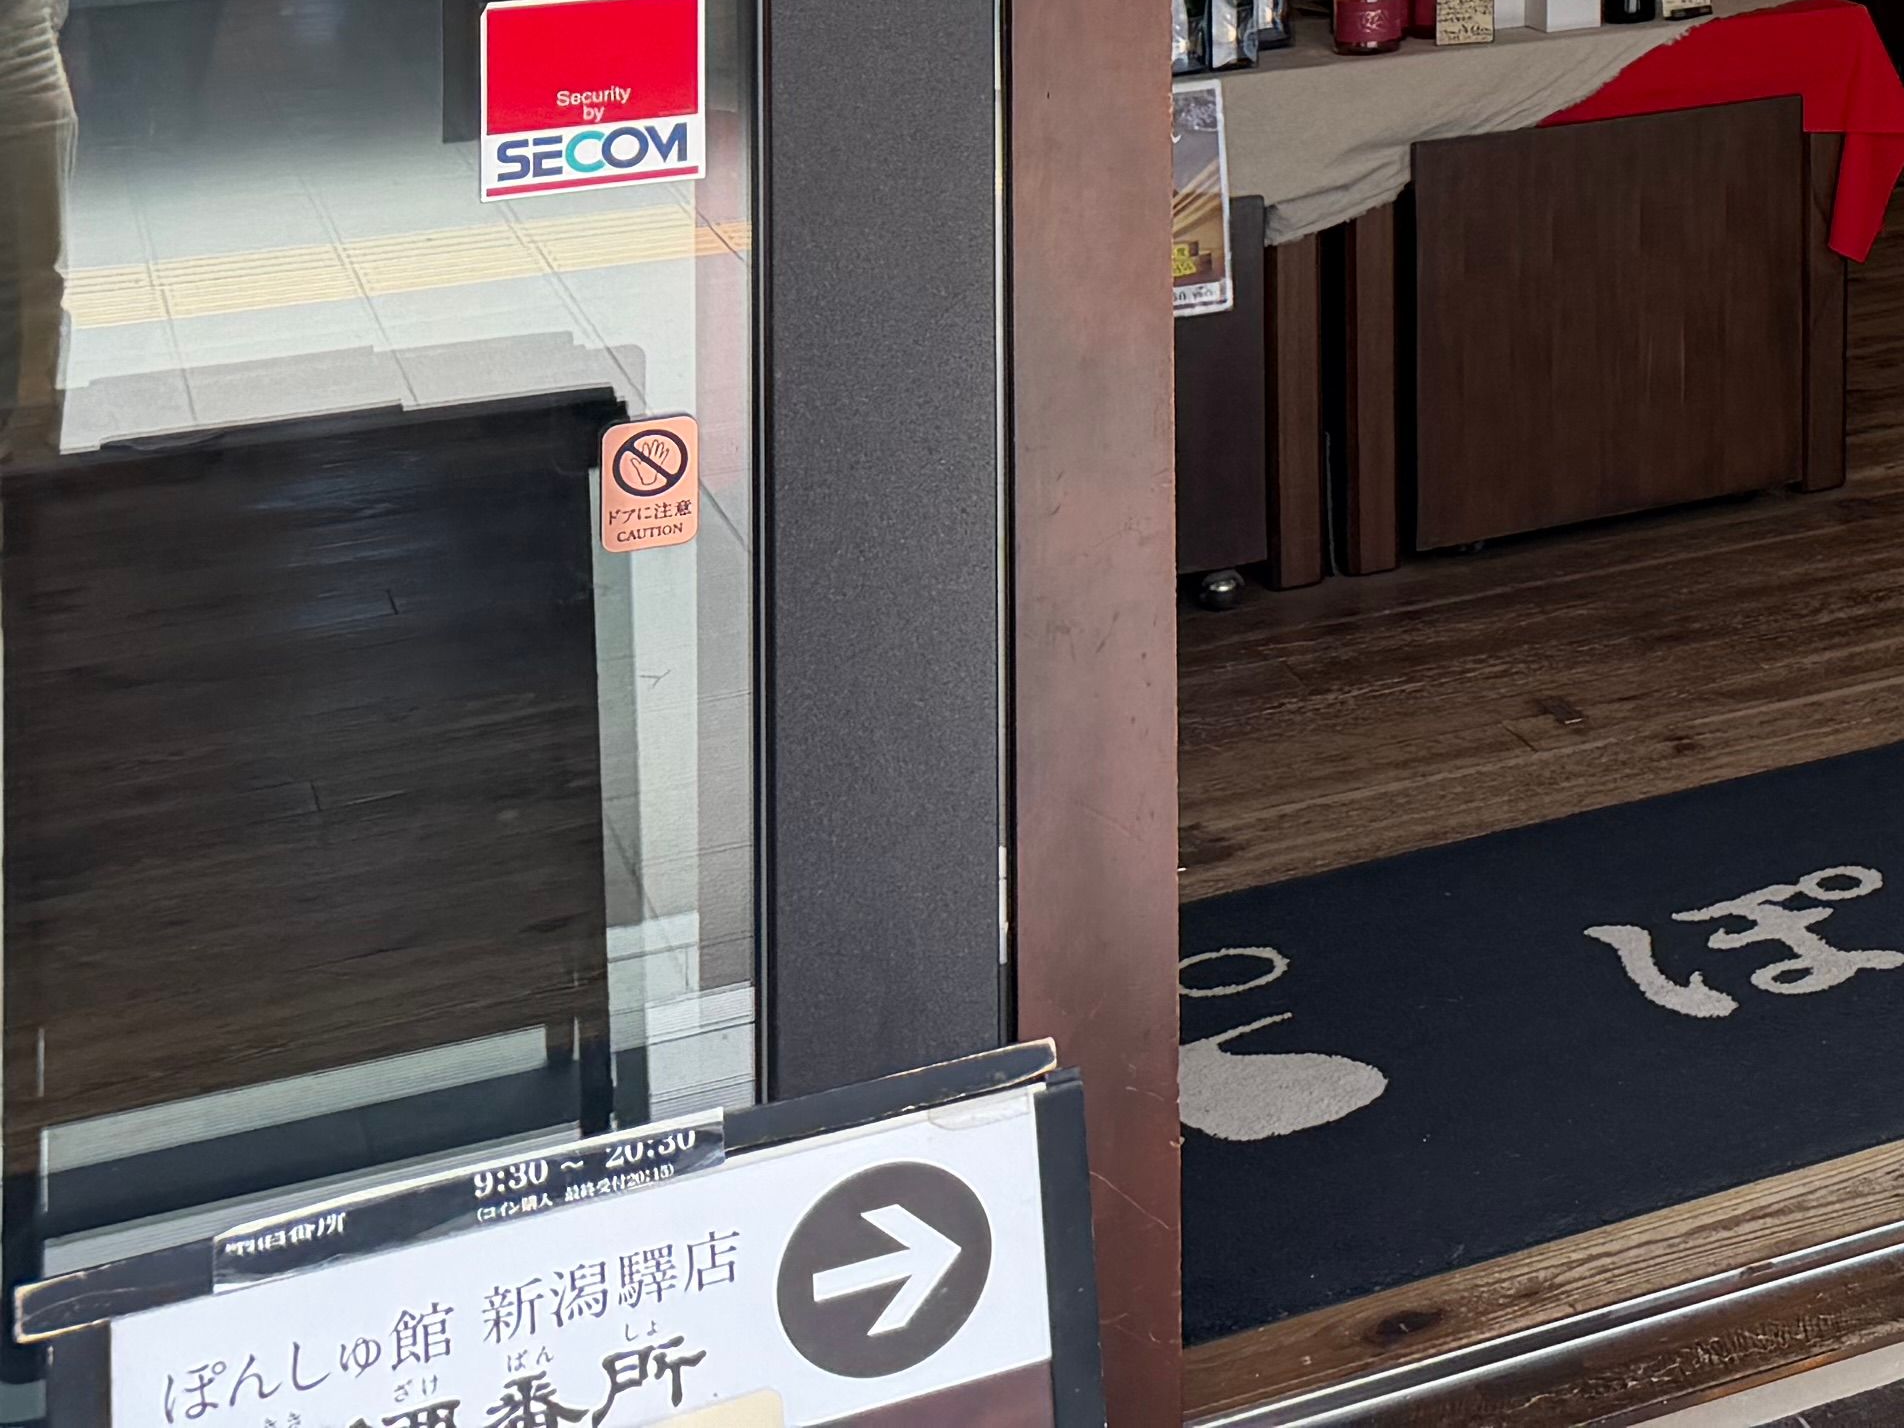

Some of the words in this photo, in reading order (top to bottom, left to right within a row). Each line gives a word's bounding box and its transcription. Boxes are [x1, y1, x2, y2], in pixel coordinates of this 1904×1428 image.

[556, 84, 631, 108] Security
[583, 103, 605, 123] by
[495, 122, 688, 183] SECOM
[608, 498, 692, 525] ドアに注意
[616, 523, 684, 544] CAUTION
[473, 1160, 549, 1198] 9:30
[164, 1302, 455, 1424] ぽんしゅ館
[481, 1230, 741, 1343] 新潟驛店
